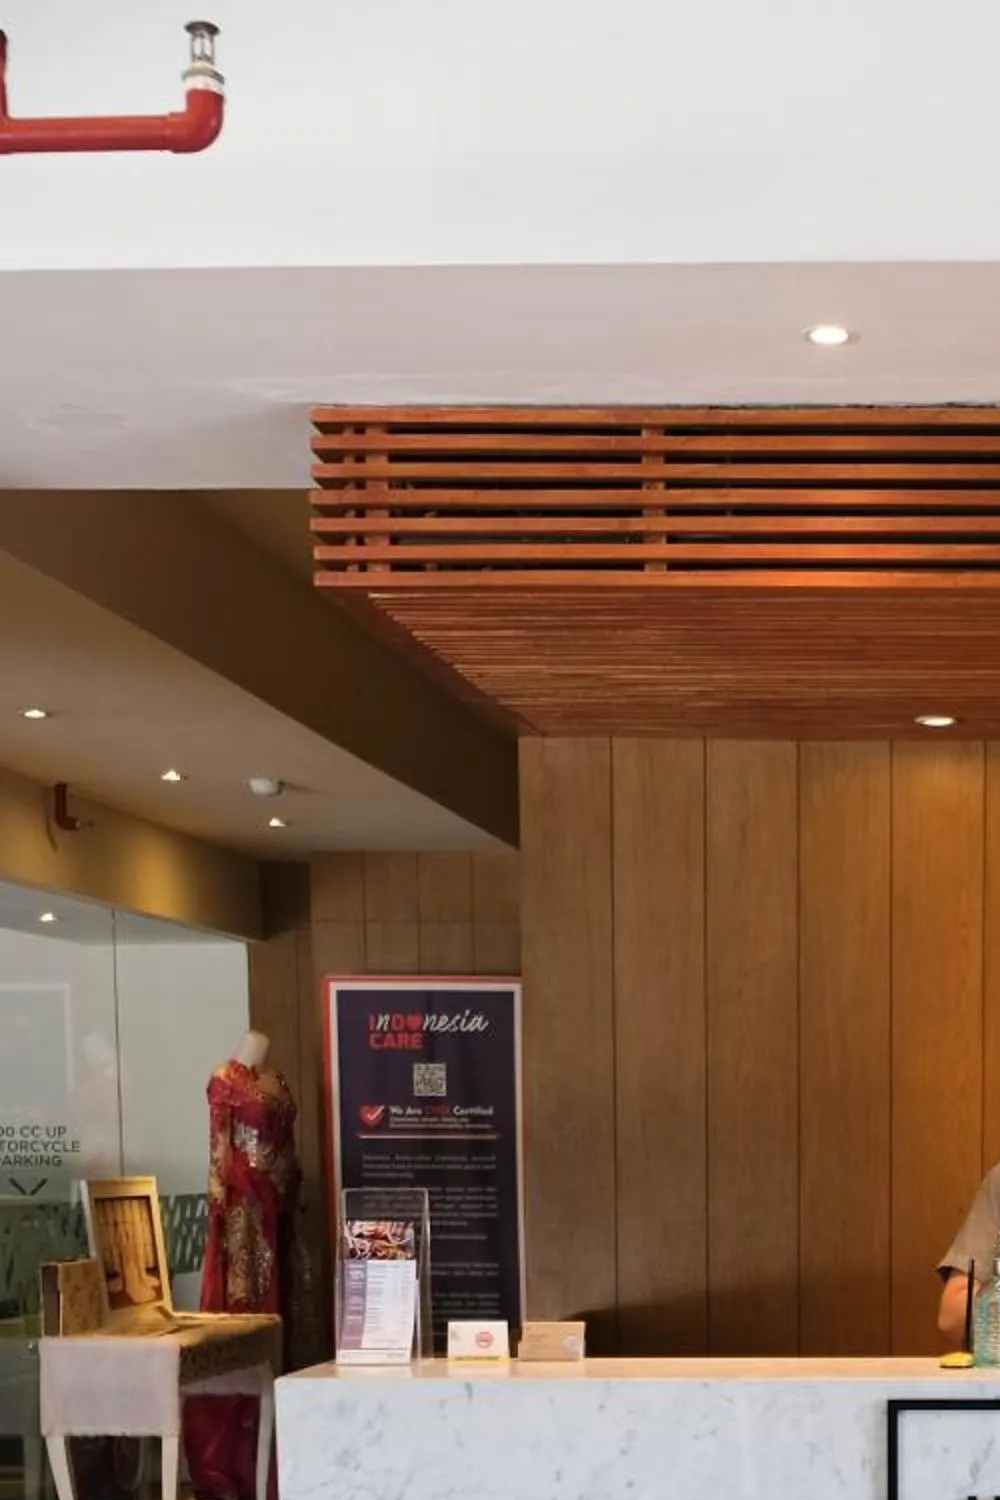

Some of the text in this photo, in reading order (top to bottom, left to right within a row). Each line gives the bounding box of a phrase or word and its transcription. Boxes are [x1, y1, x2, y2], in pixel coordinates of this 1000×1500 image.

[368, 1032, 423, 1050] CARE
[20, 1126, 41, 1138] CC
[46, 1126, 67, 1138] UP
[0, 1155, 62, 1167] ARKING
